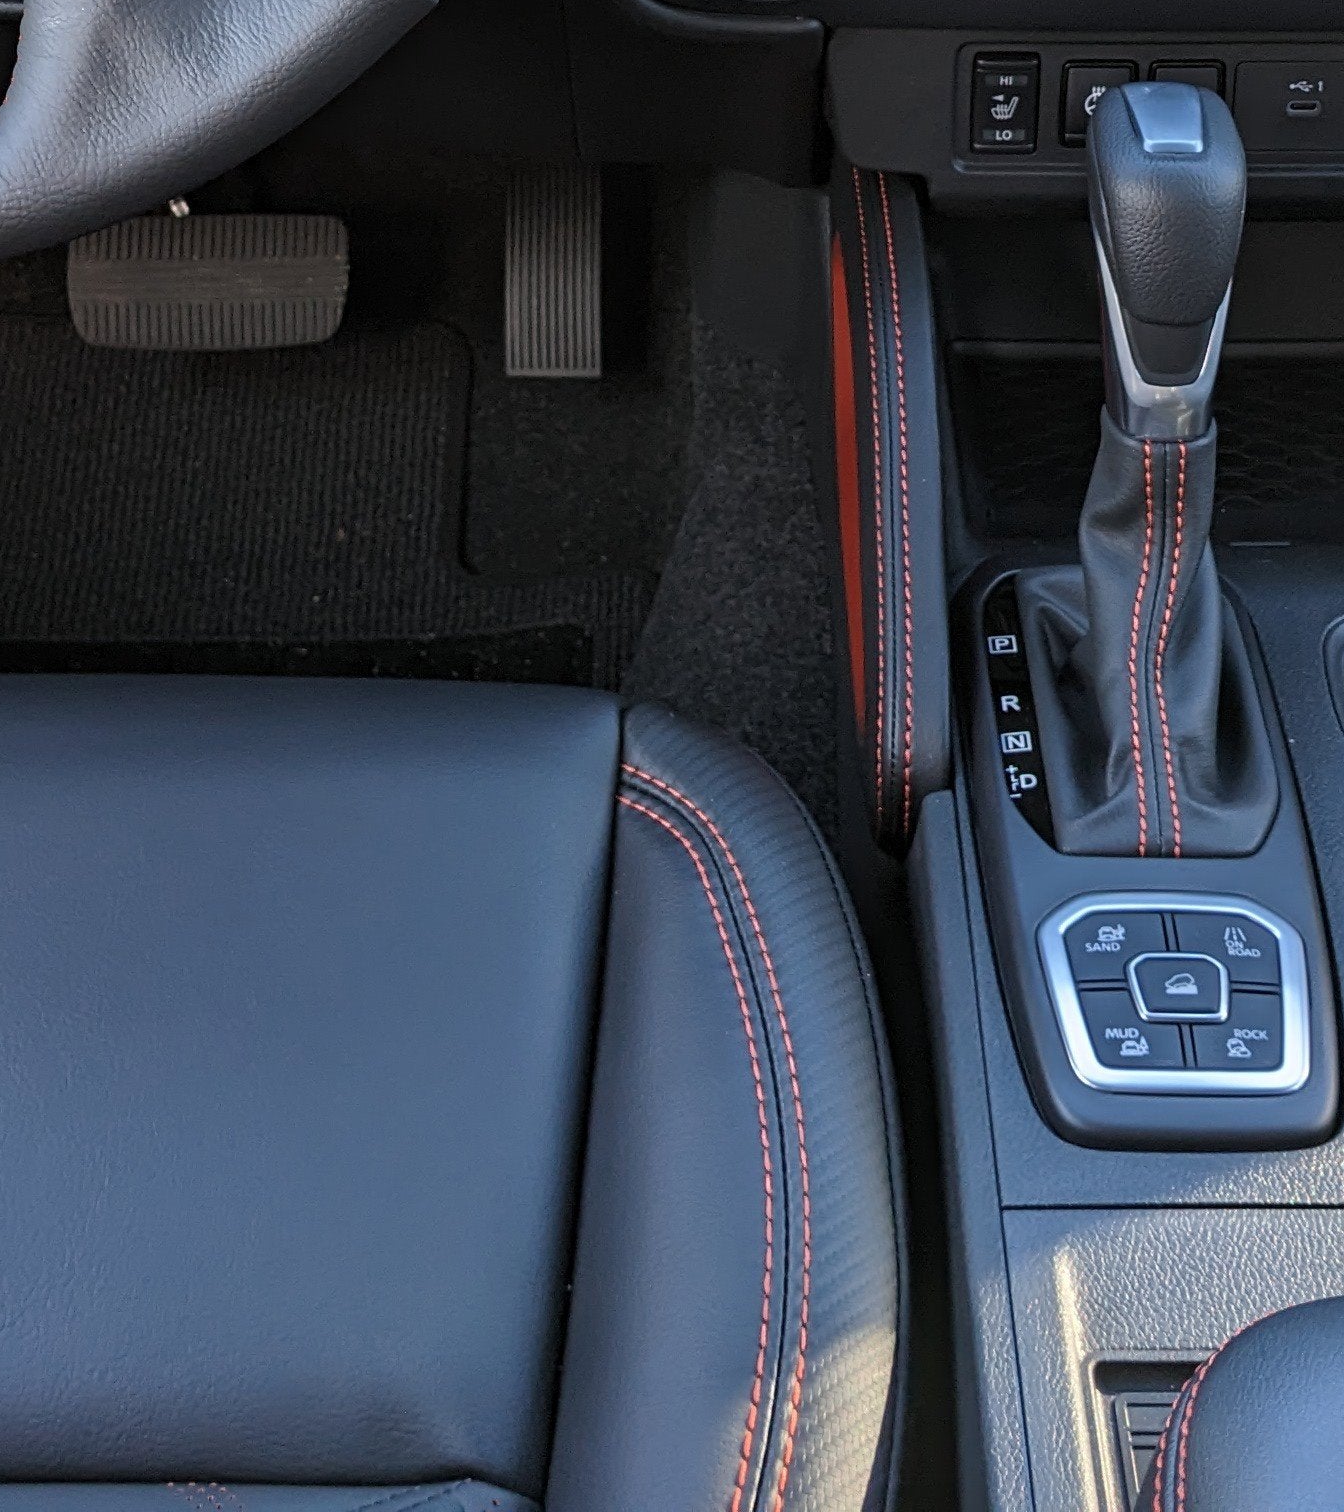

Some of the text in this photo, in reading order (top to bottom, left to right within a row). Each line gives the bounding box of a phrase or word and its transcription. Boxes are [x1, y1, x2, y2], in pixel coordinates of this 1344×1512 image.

[1000, 75, 1013, 85] HI
[1317, 81, 1324, 91] 1
[995, 130, 1012, 140] LO
[1000, 695, 1021, 712] R
[1008, 734, 1026, 750] N
[1020, 773, 1038, 789] D
[1085, 942, 1121, 952] SAND
[1225, 940, 1244, 948] ON
[1227, 948, 1261, 957] ROAD
[1105, 1028, 1139, 1038] MUD
[1233, 1028, 1269, 1040] ROCK
